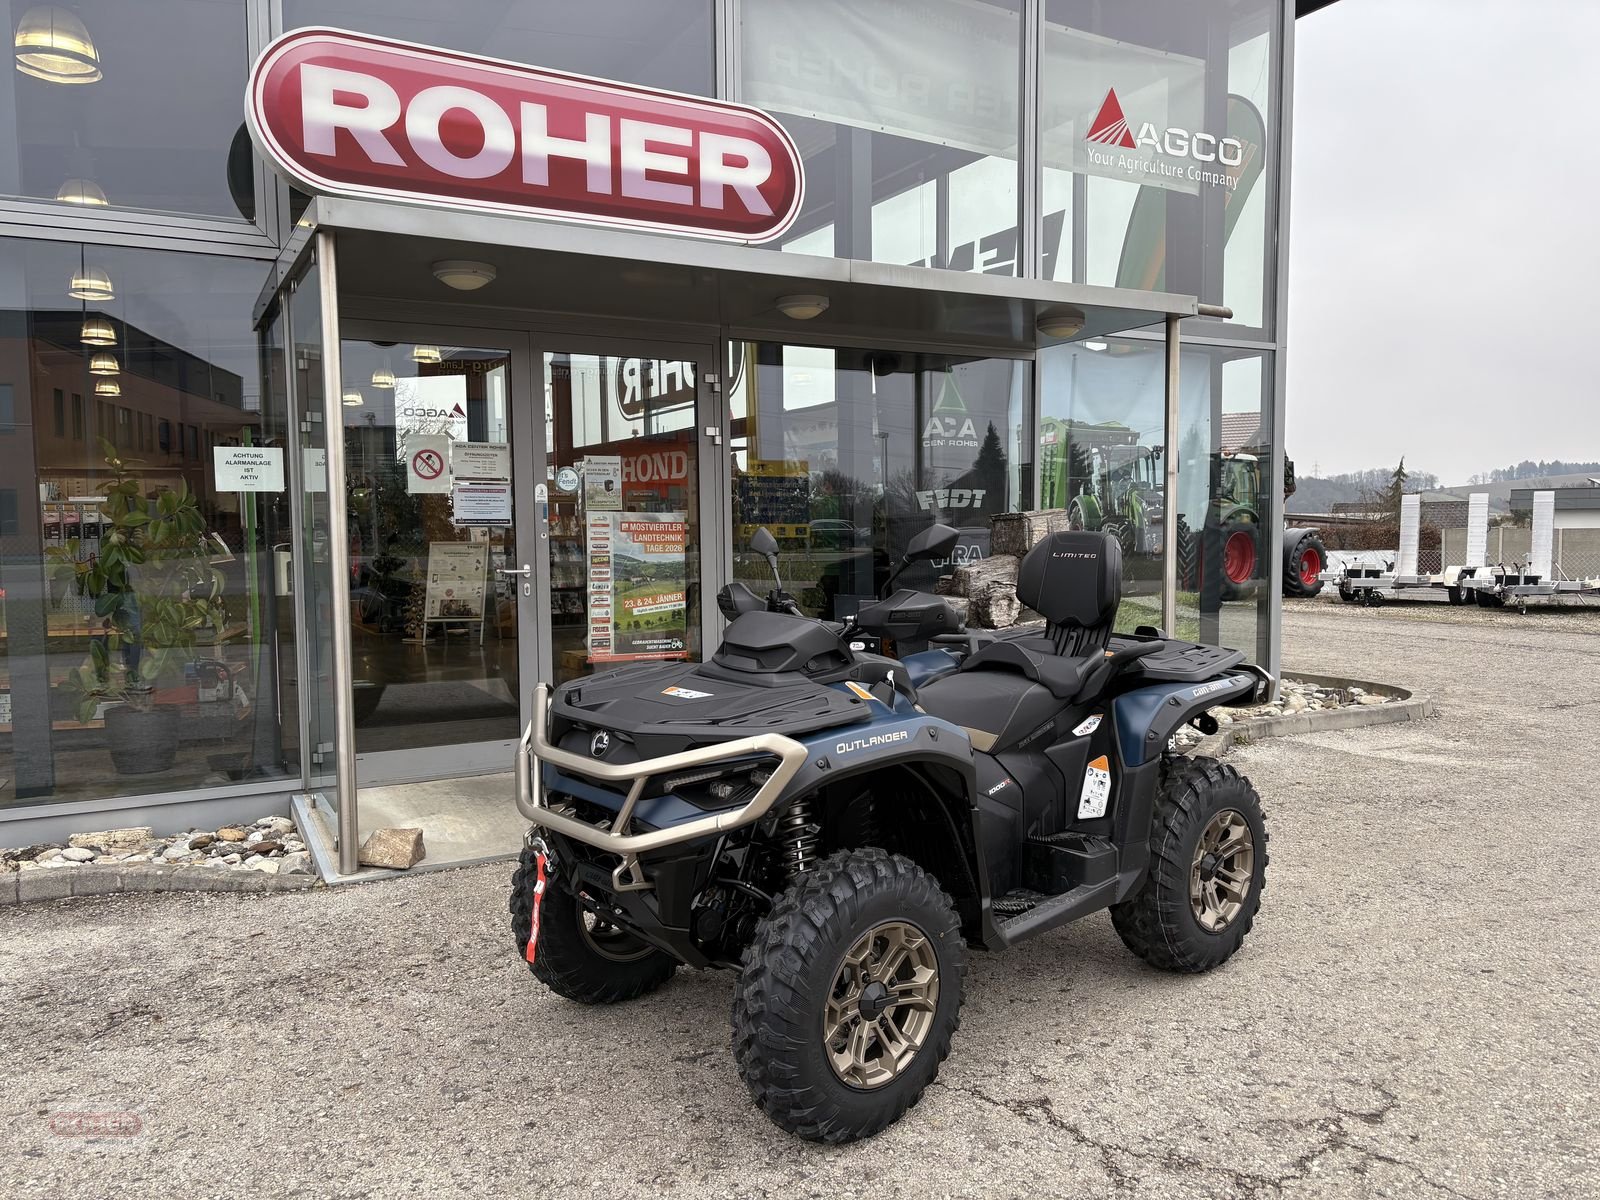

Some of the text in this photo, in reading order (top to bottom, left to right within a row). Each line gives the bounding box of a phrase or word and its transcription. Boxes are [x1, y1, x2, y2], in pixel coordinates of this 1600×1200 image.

[300, 63, 775, 217] ROHER
[1136, 122, 1242, 166] AGCO
[1087, 147, 1239, 190] Your Agriculture Company
[630, 523, 682, 532] MOSTVIERTLER
[634, 534, 682, 542] LANDTECHNIK
[646, 544, 683, 552] TAGE 2026
[624, 593, 683, 608] 23. & 24. JÄNNER
